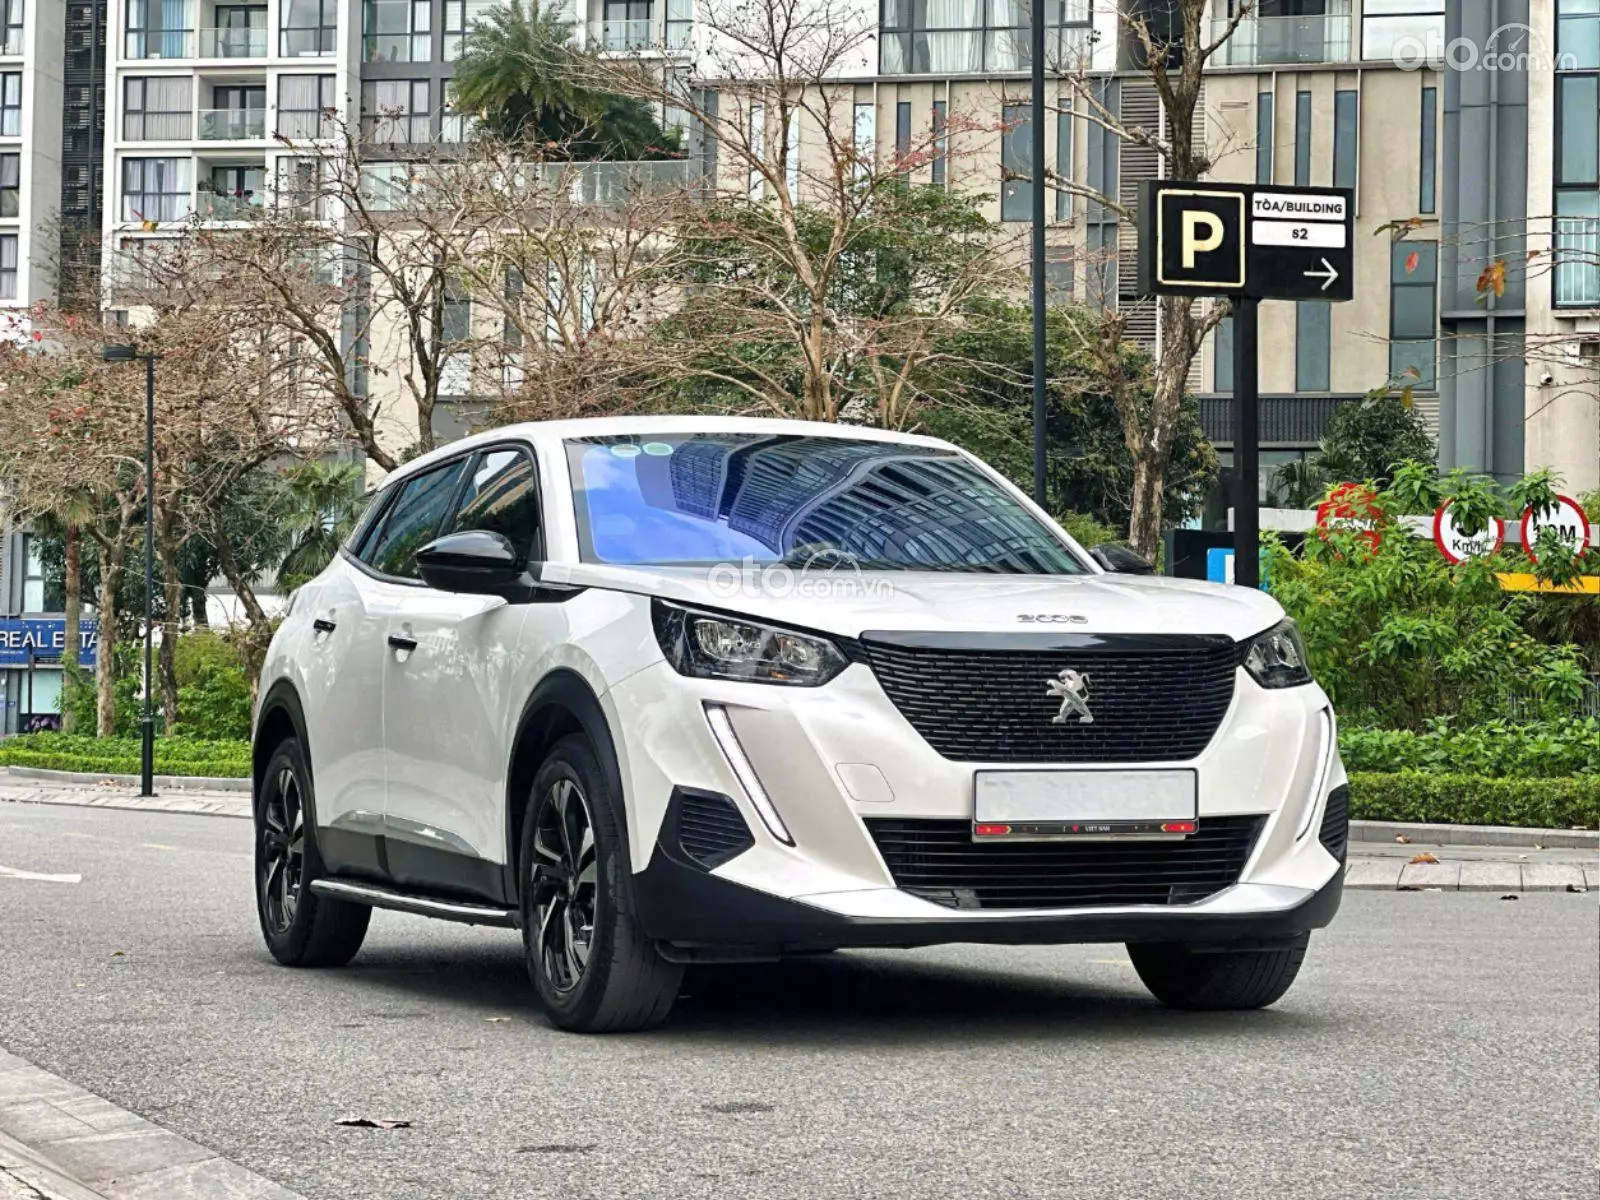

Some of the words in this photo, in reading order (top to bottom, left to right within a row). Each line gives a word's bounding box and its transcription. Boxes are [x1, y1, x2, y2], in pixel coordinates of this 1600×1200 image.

[1255, 199, 1343, 214] TÒA/BUILDING
[1182, 210, 1224, 269] P
[1292, 228, 1308, 240] S2
[0, 631, 48, 648] REAL
